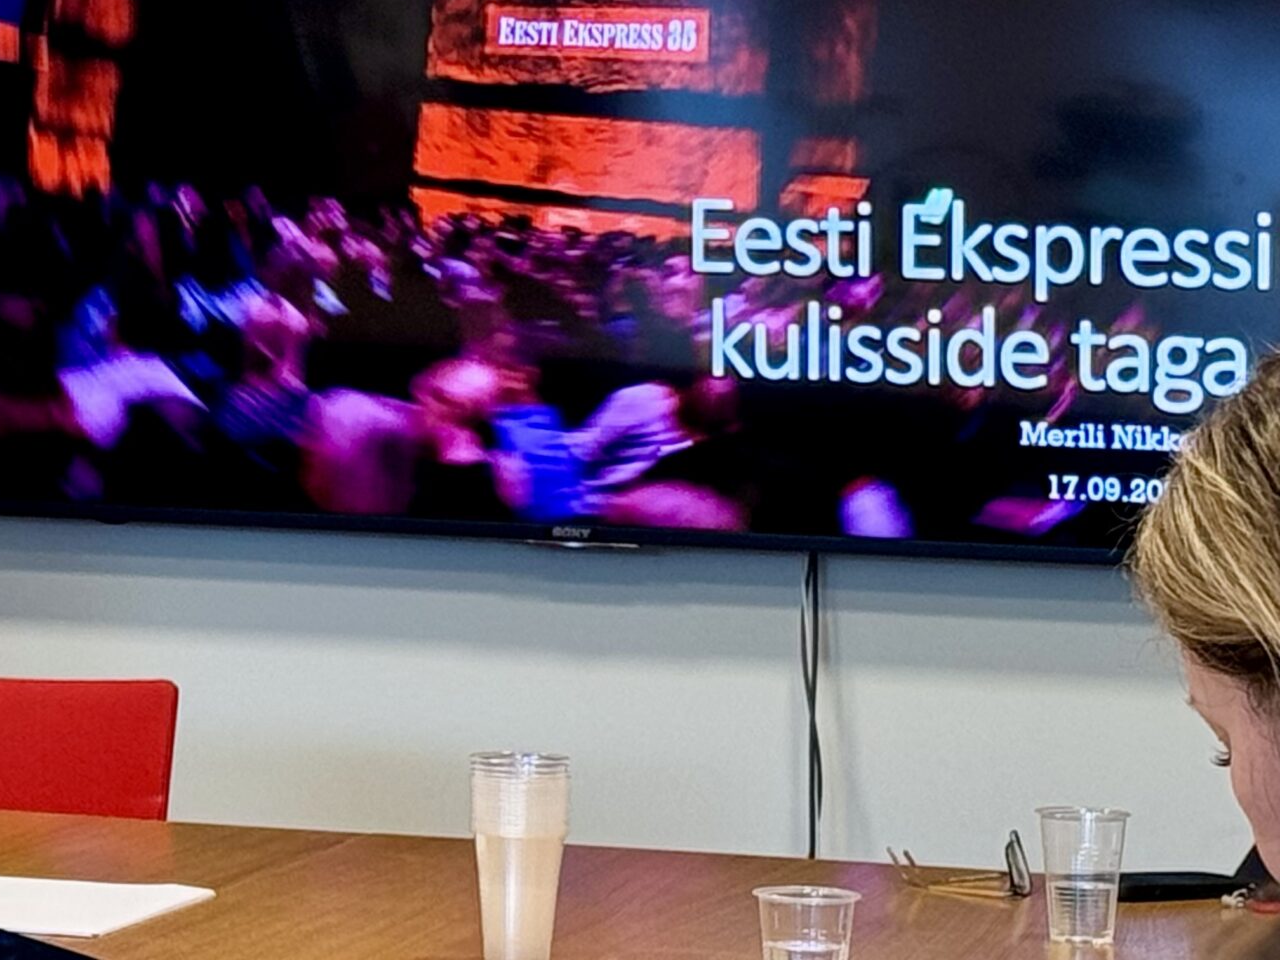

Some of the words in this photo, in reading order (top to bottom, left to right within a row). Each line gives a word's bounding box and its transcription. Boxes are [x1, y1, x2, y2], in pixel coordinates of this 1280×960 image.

[499, 16, 558, 46] EESTI
[563, 19, 663, 50] EKSPRESS
[691, 197, 873, 278] Eesti
[902, 199, 1272, 302] Ekspressi
[710, 298, 1050, 390] kulisside
[1070, 319, 1248, 414] taga
[1019, 420, 1106, 449] Merili
[1111, 423, 1188, 452] Nikk
